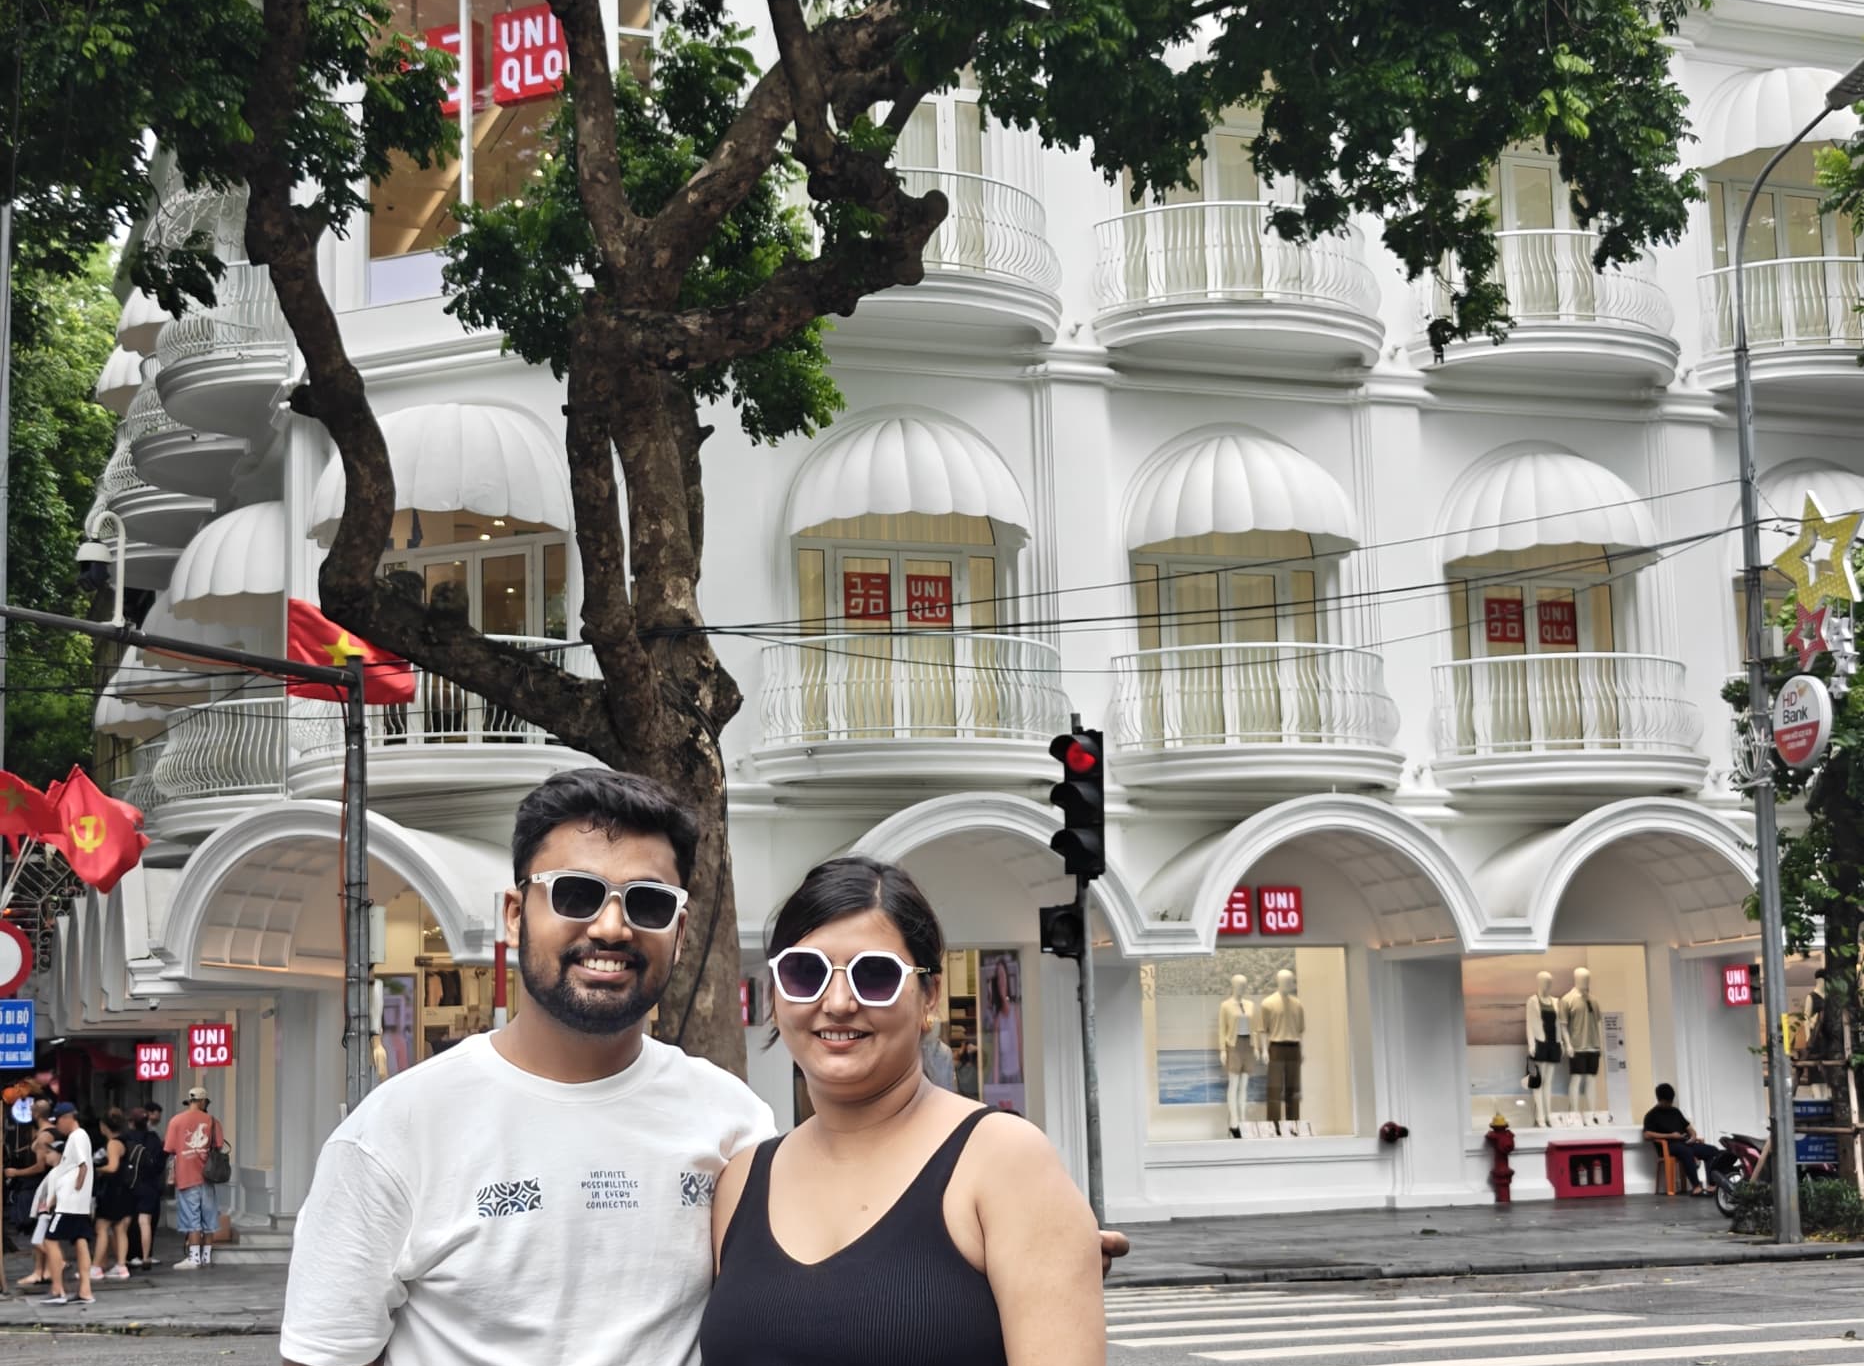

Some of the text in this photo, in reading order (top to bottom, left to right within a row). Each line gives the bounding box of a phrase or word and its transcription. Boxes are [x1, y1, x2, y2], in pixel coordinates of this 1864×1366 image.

[501, 11, 557, 53] UNI
[501, 49, 563, 94] QLO
[911, 581, 943, 598] UNI
[911, 601, 946, 620] QLO
[1541, 606, 1568, 621] UNI
[1543, 625, 1571, 642] QLO
[1782, 691, 1798, 708] HD
[1782, 705, 1808, 725] Bank
[1264, 892, 1295, 909] UNI
[1265, 911, 1299, 931] QLO
[1726, 969, 1746, 985] UNI
[1727, 985, 1748, 1003] QLO
[193, 1029, 225, 1045] UNI
[140, 1048, 167, 1062] UNI
[193, 1046, 228, 1065] QLO
[140, 1062, 169, 1079] QLO
[590, 1171, 626, 1179] INFINITE
[581, 1180, 639, 1188] POSSIBILITIES
[591, 1191, 631, 1199] IN EVERY
[585, 1200, 639, 1209] CONNECTION
